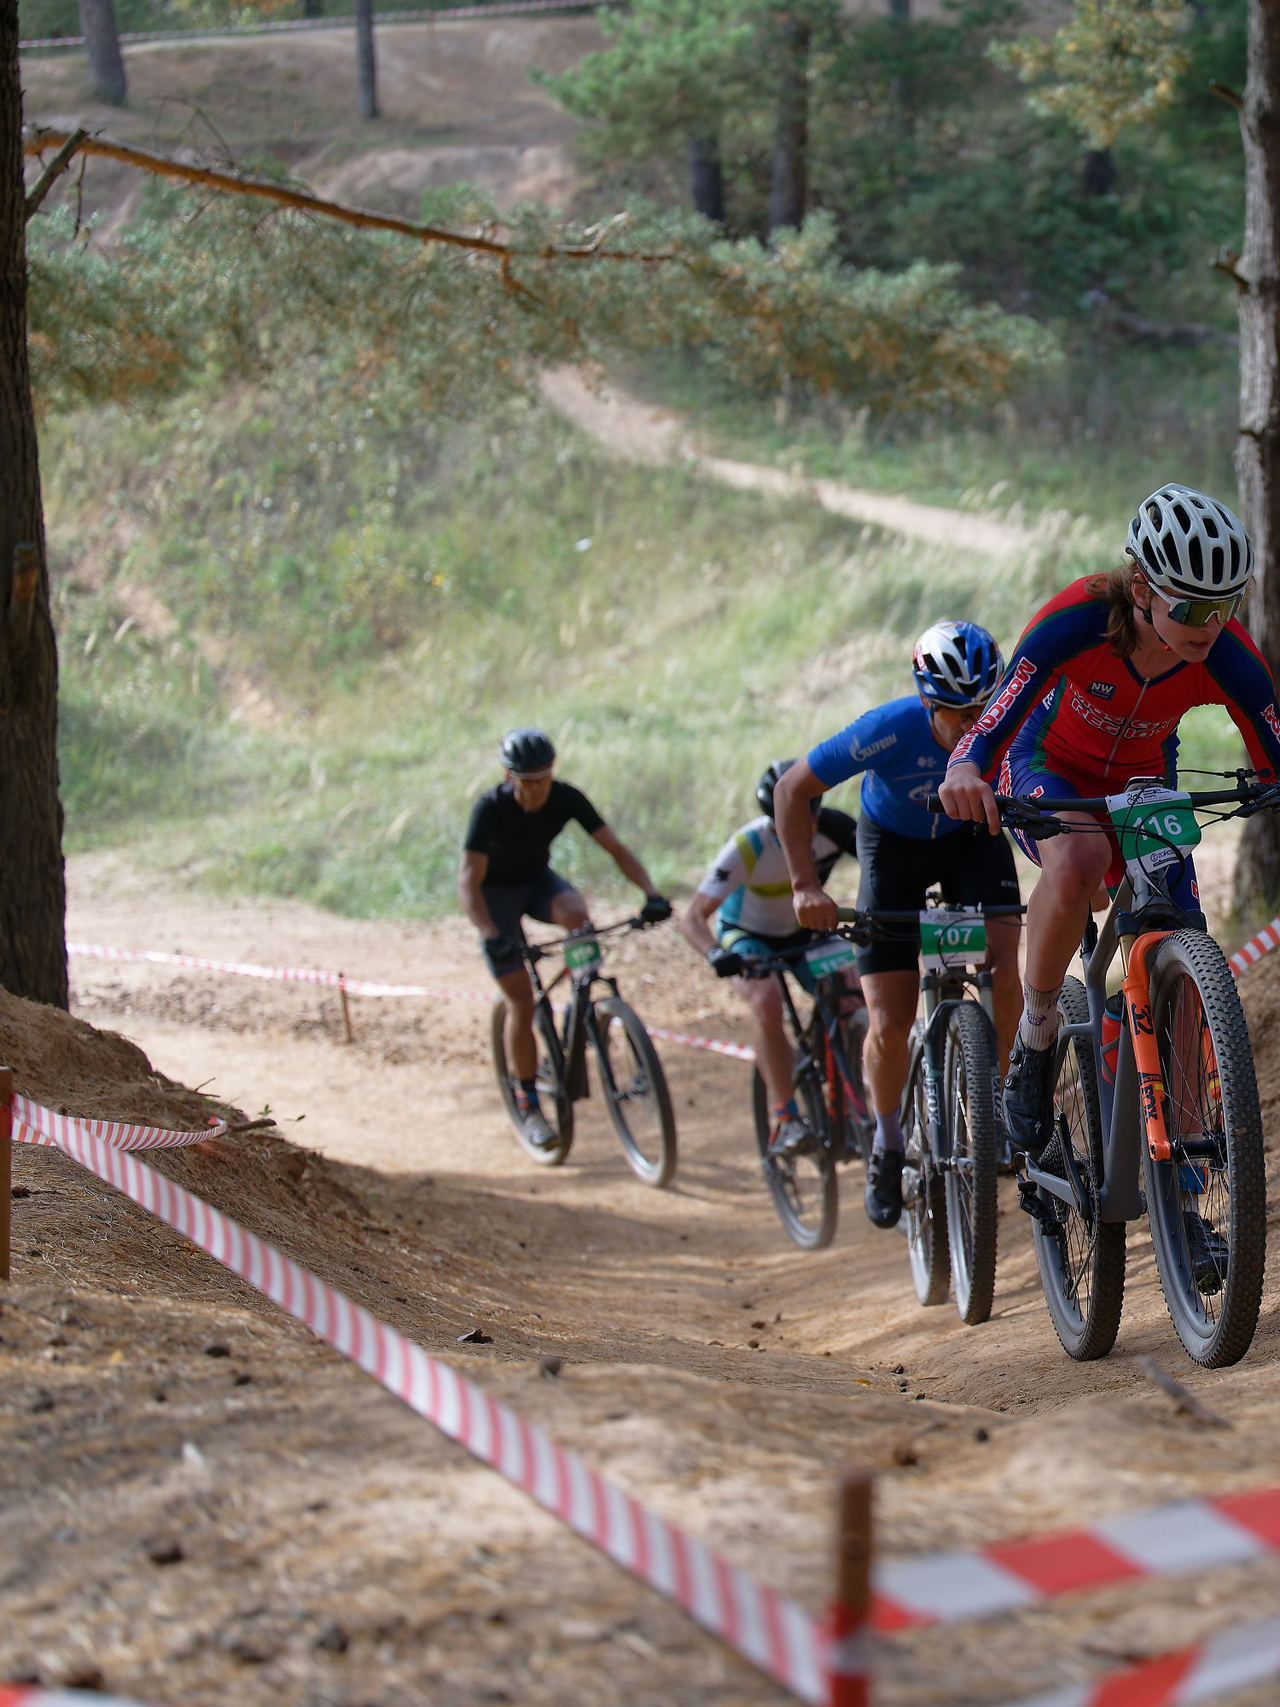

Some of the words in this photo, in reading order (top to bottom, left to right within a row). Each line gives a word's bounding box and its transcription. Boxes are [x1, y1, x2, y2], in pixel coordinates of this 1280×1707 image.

[1090, 682, 1114, 694] NW
[1069, 683, 1178, 727] OSCO
[1070, 697, 1162, 740] REGIO
[1132, 814, 1183, 841] 116
[933, 927, 974, 947] 107
[1131, 1003, 1155, 1036] 32
[1141, 1084, 1158, 1124] FOX
